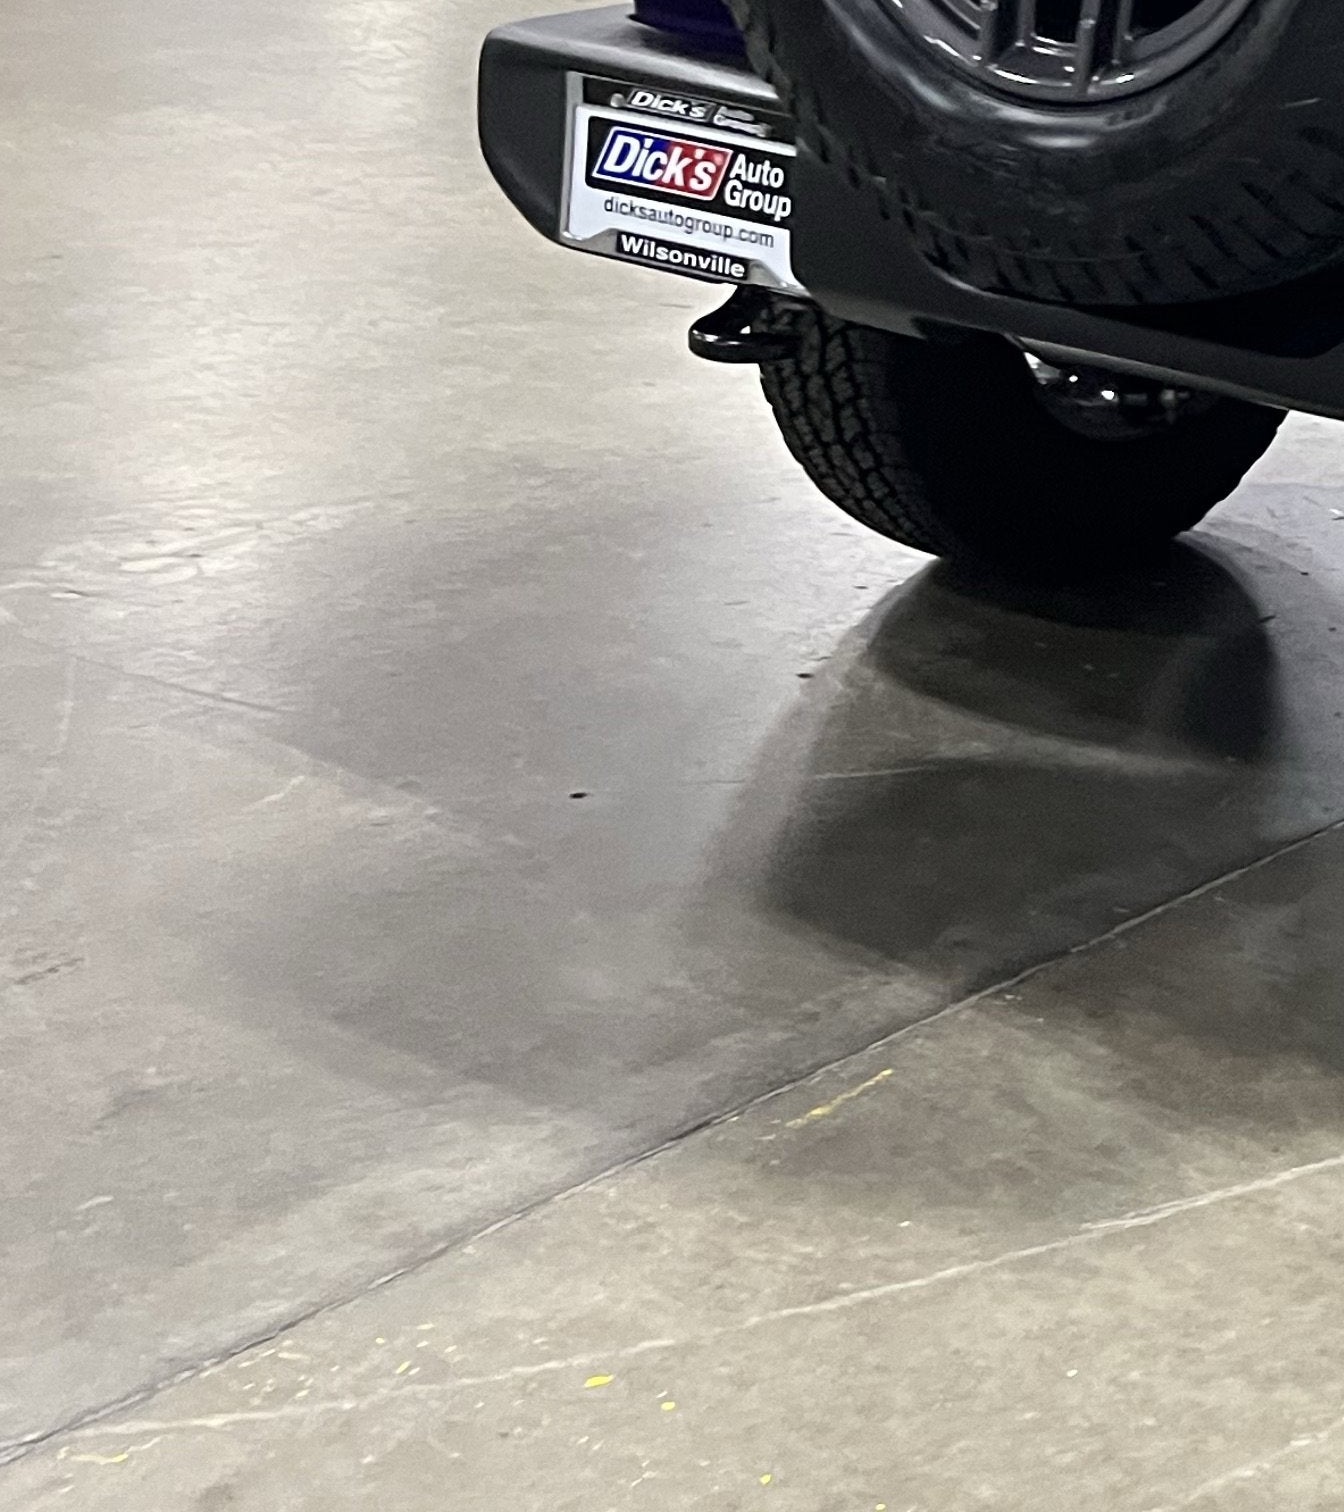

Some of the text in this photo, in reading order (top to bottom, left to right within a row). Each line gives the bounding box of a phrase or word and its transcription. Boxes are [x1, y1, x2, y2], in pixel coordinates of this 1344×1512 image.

[631, 91, 706, 118] Dick's
[603, 134, 717, 191] Dick's
[729, 153, 785, 188] Auto
[604, 196, 775, 248] dicksautogroup.com
[724, 179, 792, 222] Group
[620, 234, 746, 278] Wilsonville
